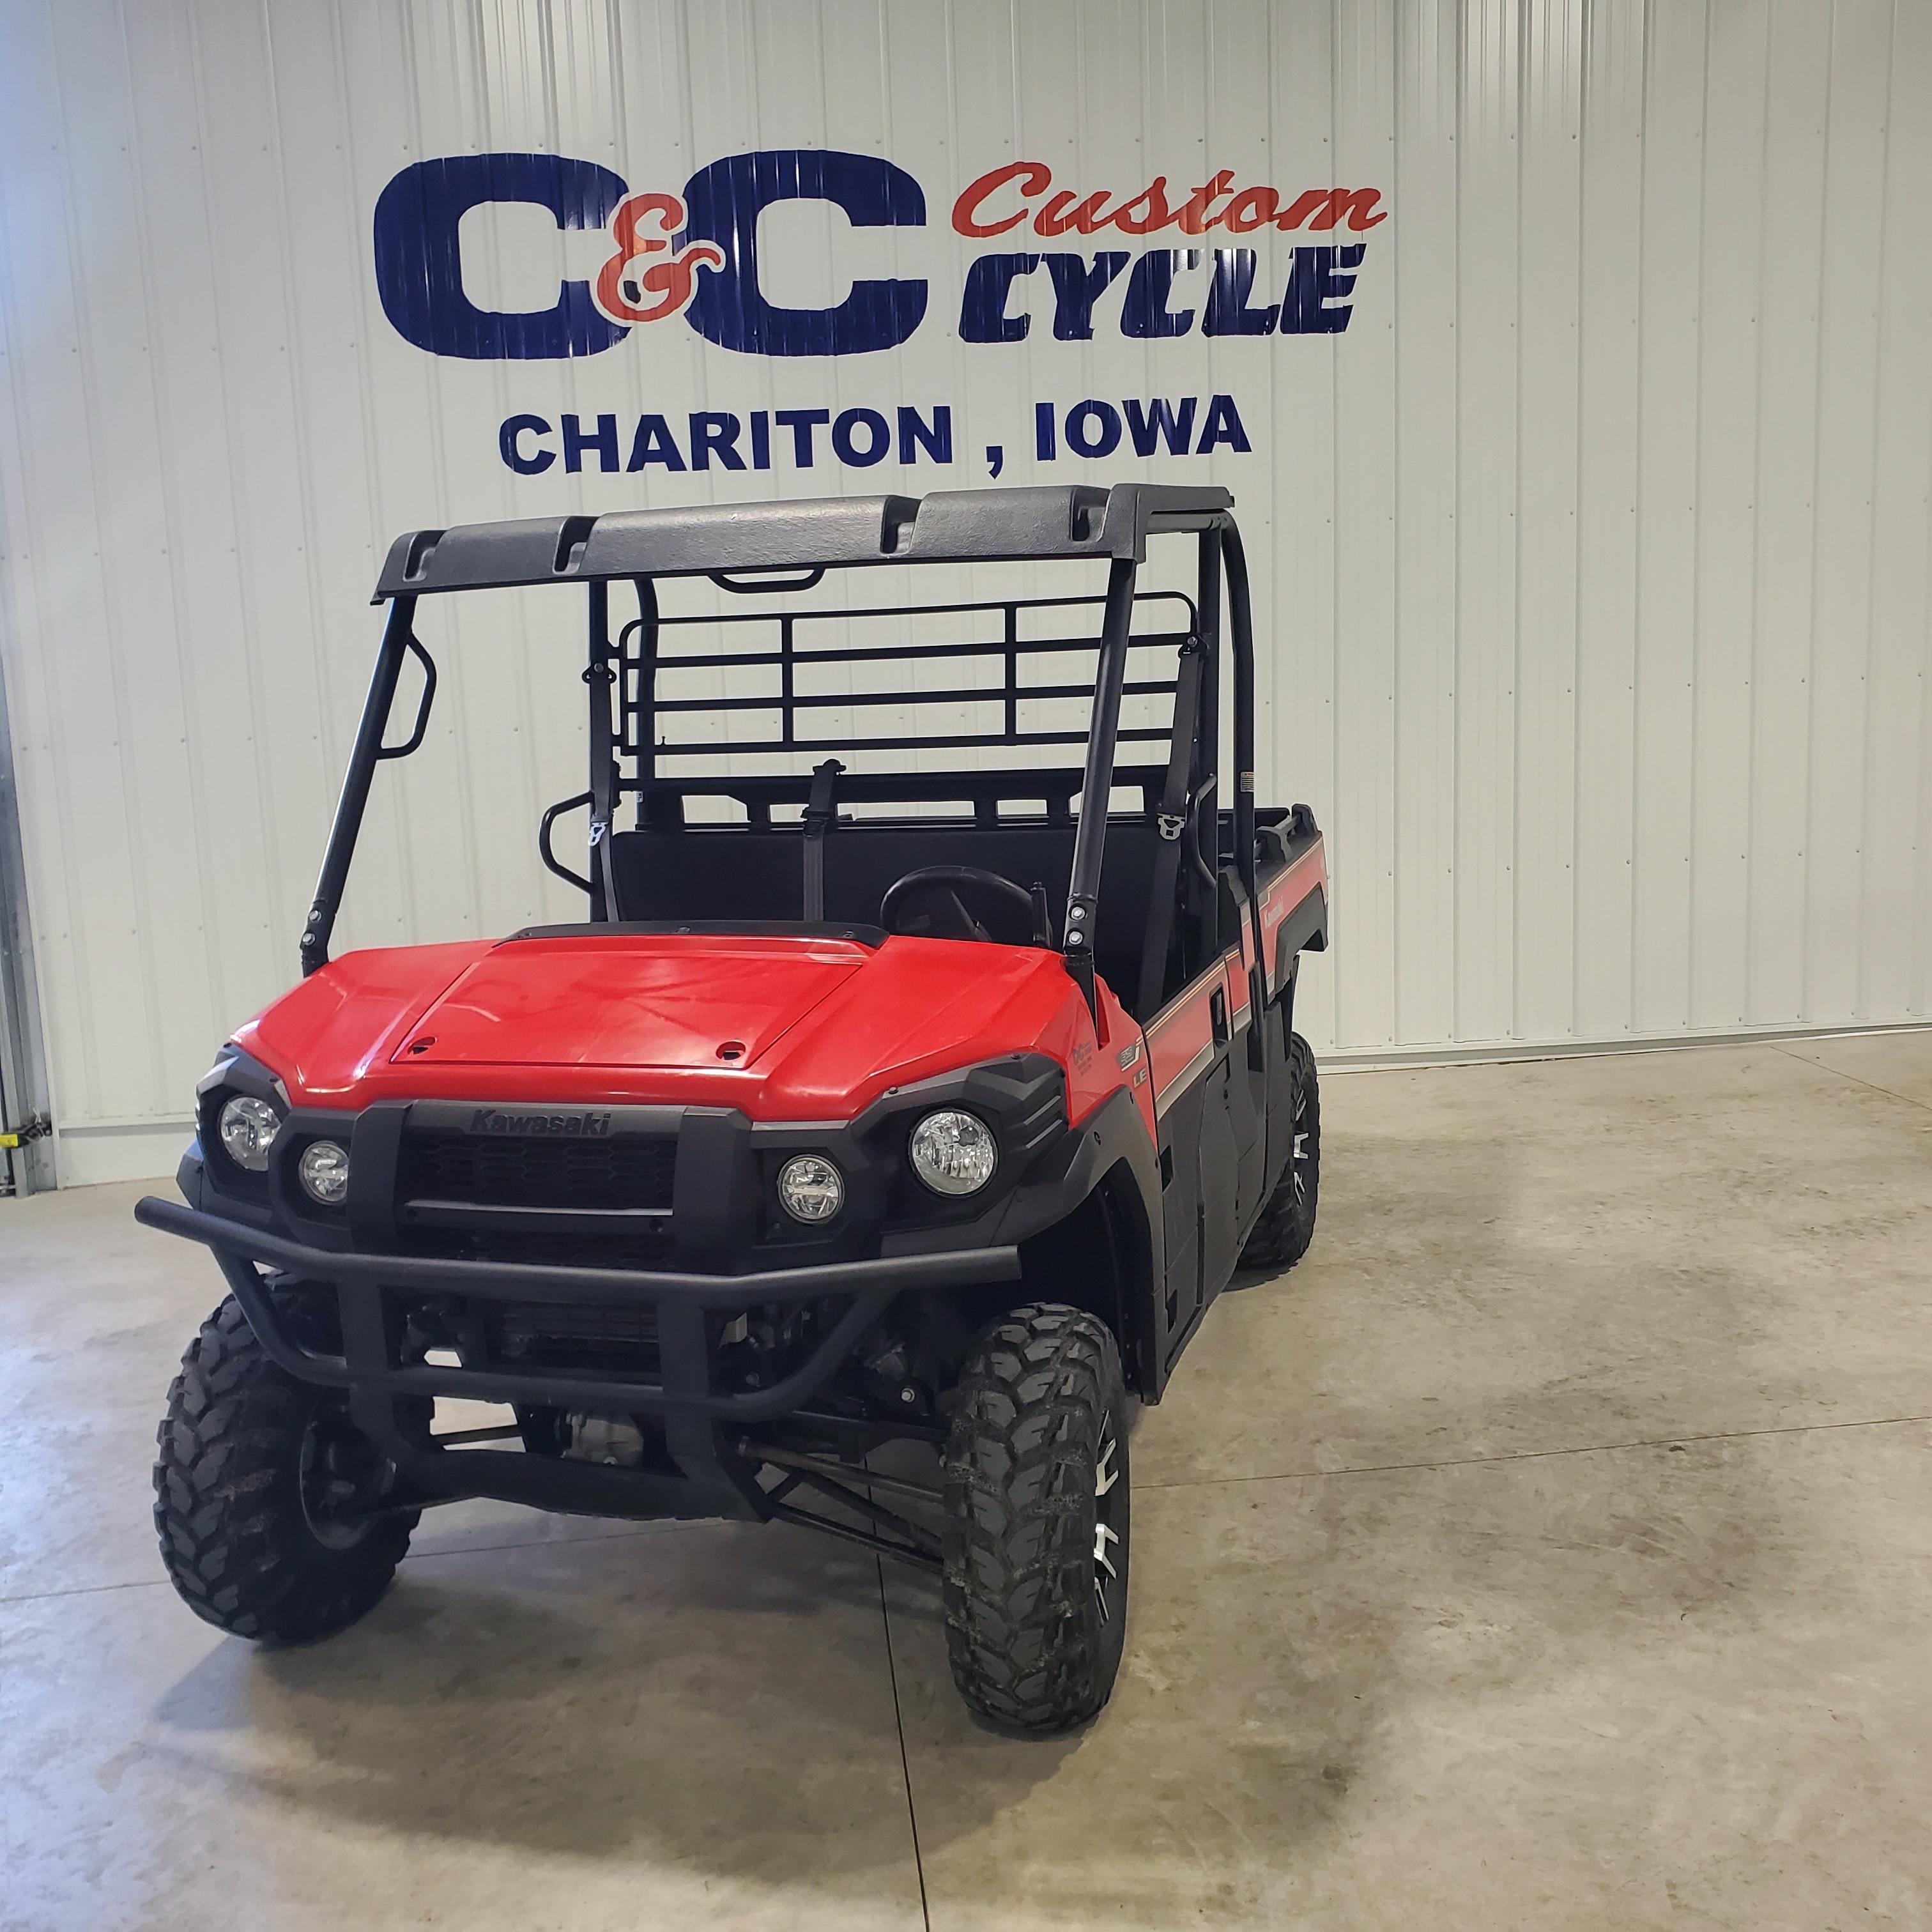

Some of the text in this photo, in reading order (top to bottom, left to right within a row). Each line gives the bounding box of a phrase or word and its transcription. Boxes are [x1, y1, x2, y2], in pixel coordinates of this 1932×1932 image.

[952, 162, 1387, 238] Custom
[374, 150, 928, 359] C&C
[960, 243, 1367, 342] CYCLE
[1036, 395, 1251, 461] IOWA
[1133, 1068, 1147, 1087] LE
[470, 1110, 611, 1135] Kawasaki
